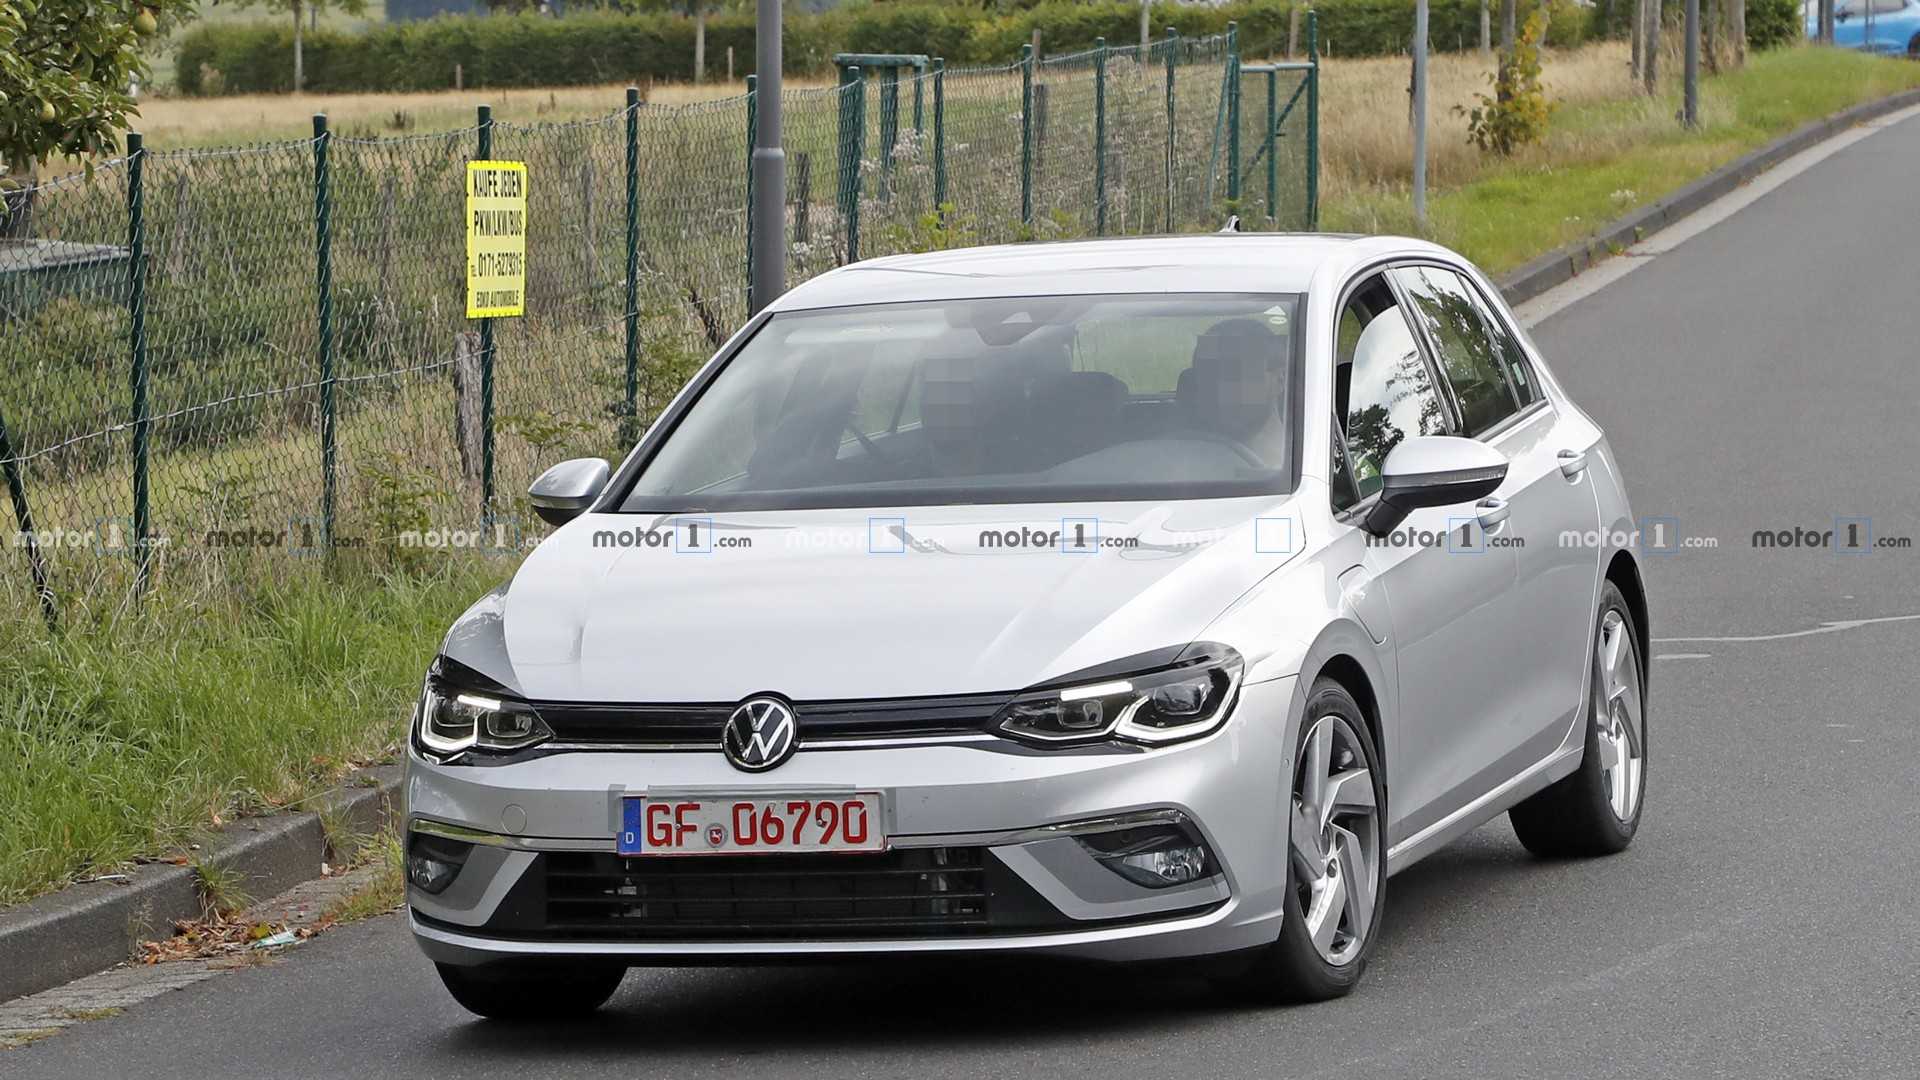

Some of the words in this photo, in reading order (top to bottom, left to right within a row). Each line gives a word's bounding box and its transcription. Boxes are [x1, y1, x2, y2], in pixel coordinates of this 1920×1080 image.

[473, 170, 497, 197] KAUFE
[501, 170, 522, 197] JEDEN
[646, 802, 700, 847] GF
[732, 801, 868, 846] 06790
[625, 832, 634, 844] D
